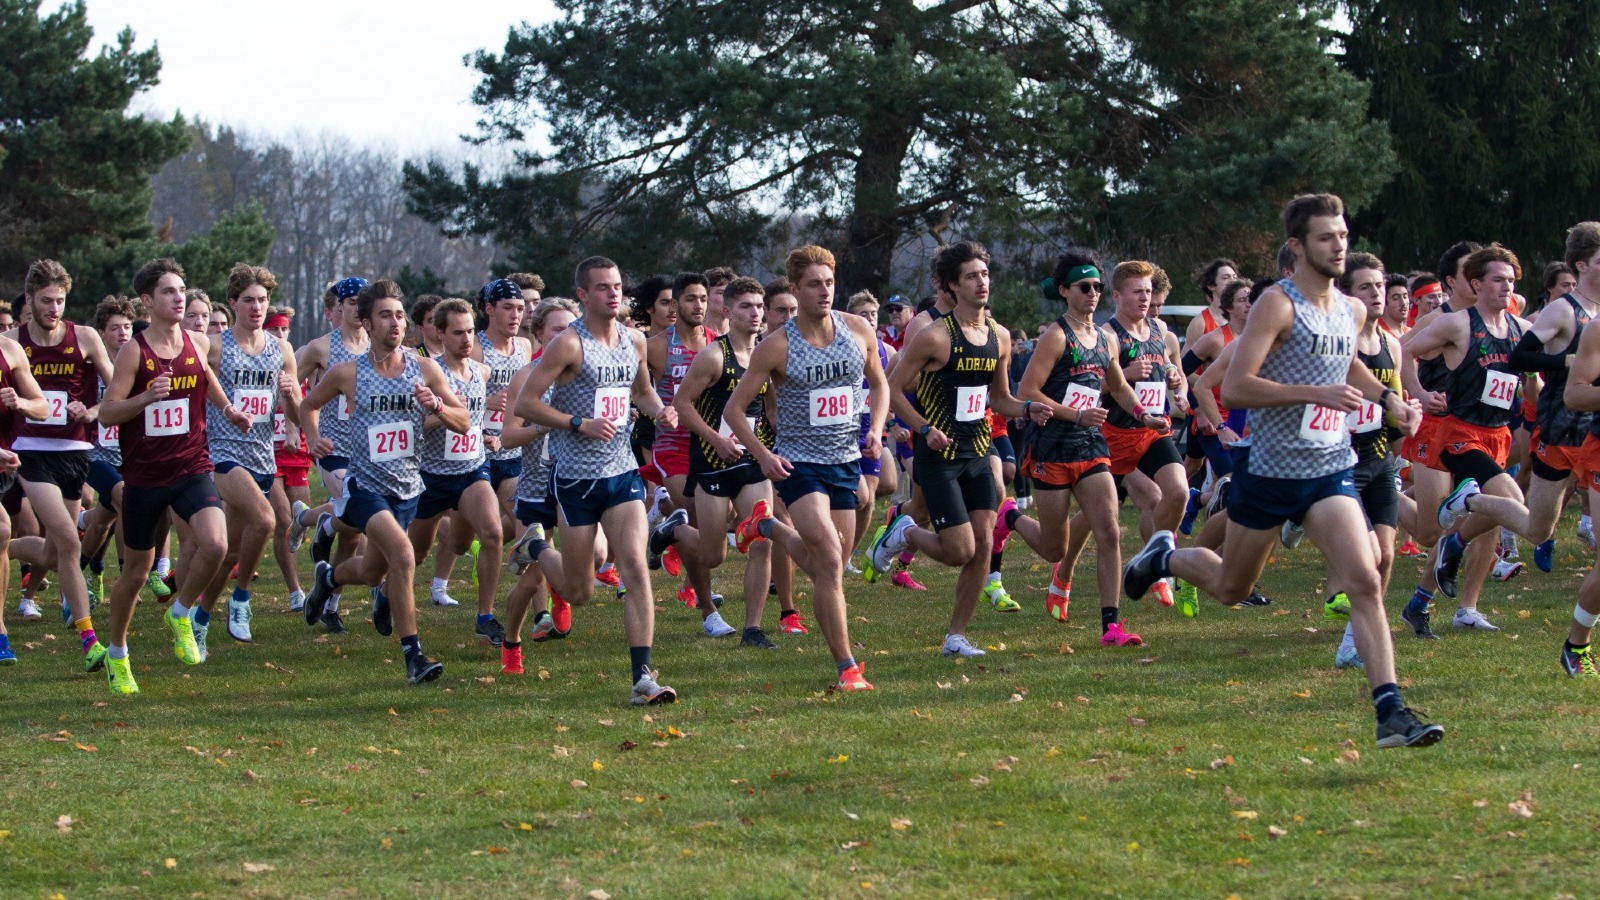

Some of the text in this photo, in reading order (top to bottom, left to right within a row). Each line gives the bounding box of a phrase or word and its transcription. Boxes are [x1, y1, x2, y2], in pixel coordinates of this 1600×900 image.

[1310, 333, 1351, 356] TRINE
[597, 366, 631, 382] TRINE
[805, 360, 849, 383] TRINE
[956, 358, 997, 372] ADRIAN
[234, 369, 274, 386] TRINE
[1140, 388, 1161, 407] 221
[1488, 378, 1514, 402] 216
[241, 396, 268, 416] 296
[369, 393, 414, 412] TRINE
[601, 396, 626, 419] 305
[816, 394, 848, 418] 289
[967, 394, 982, 414] 16
[1357, 401, 1375, 426] 14
[153, 406, 183, 429] 113
[1309, 404, 1340, 432] 286
[375, 429, 409, 454] 279
[450, 434, 477, 454] 292
